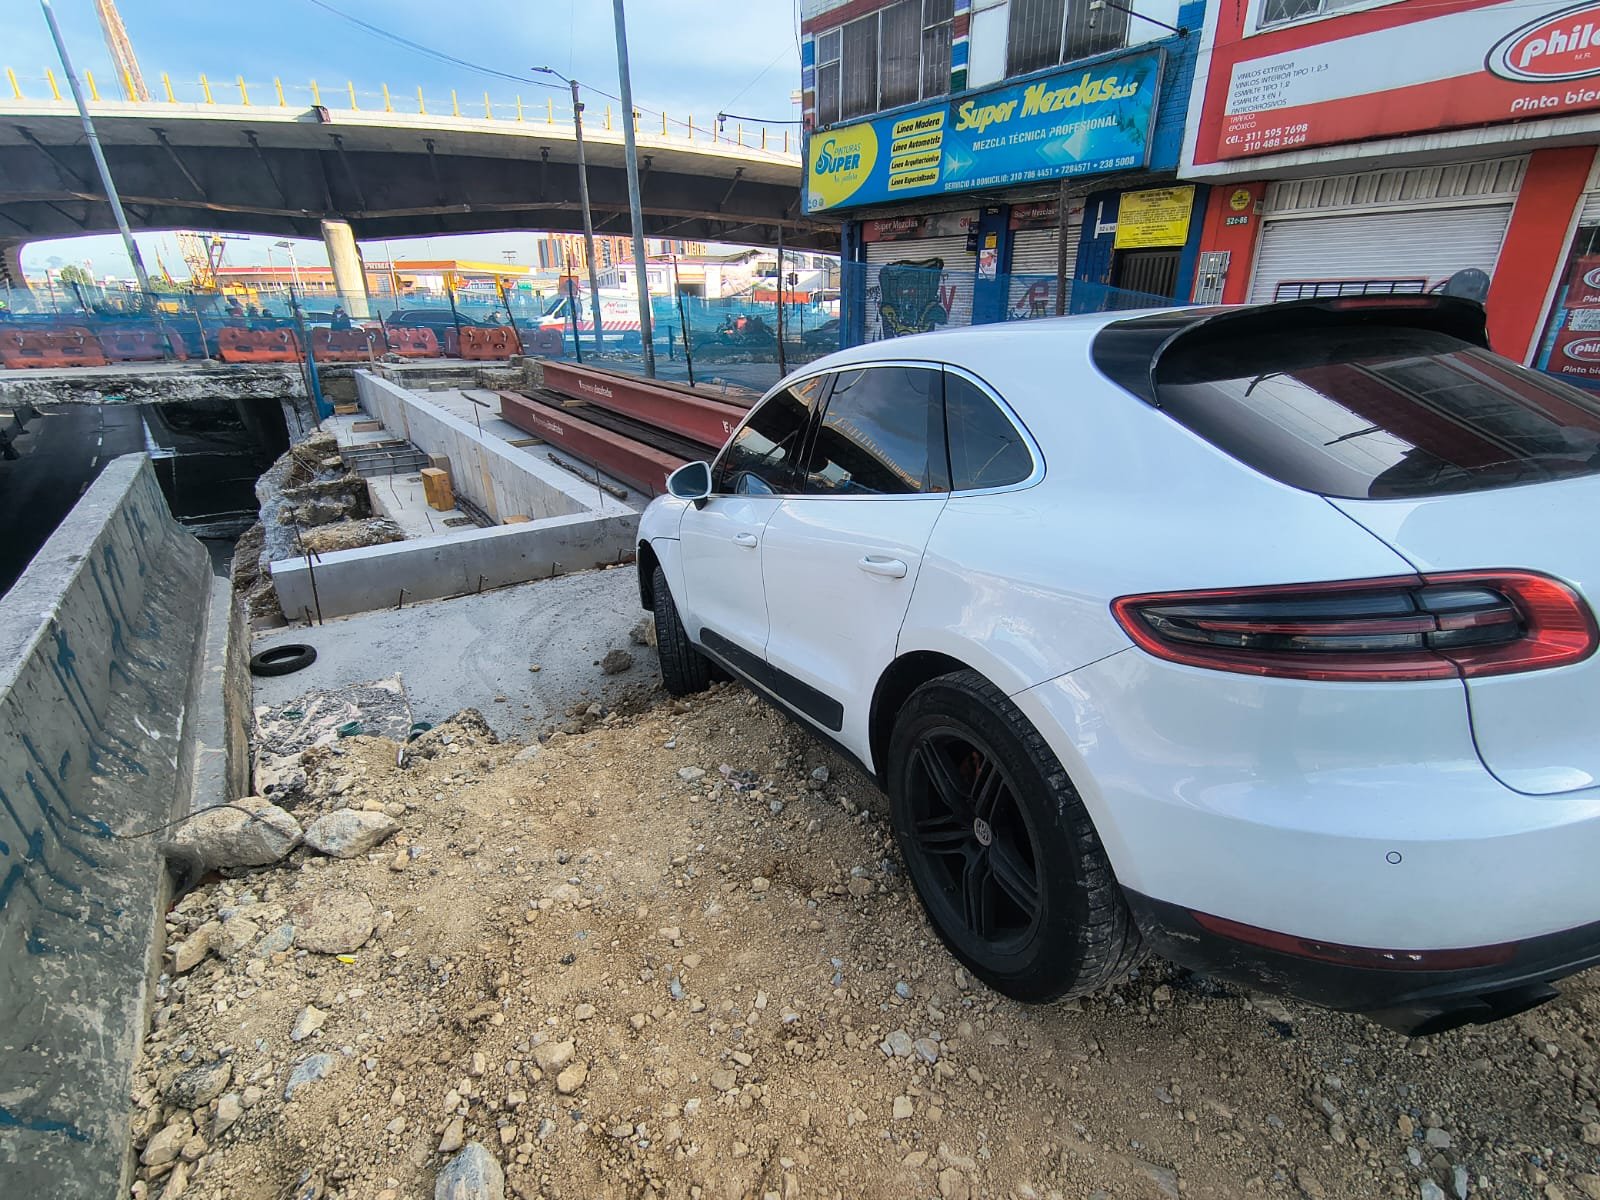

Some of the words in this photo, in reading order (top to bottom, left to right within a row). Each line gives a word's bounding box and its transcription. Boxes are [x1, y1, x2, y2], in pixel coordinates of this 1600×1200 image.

[1293, 67, 1309, 77] TIPO
[1234, 87, 1261, 97] ESMALTE
[1263, 83, 1278, 92] TIPO
[955, 100, 1018, 134] Super
[1020, 73, 1118, 118] Mezclas
[1232, 96, 1259, 106] ESMALTE
[1510, 95, 1559, 112] Pinta
[914, 118, 940, 130] Madera
[972, 138, 1006, 152] MEZCLA
[1008, 129, 1046, 145] TÉCNICA
[1049, 115, 1118, 138] PROFESIONAL
[1245, 131, 1261, 142] 311
[1264, 128, 1281, 138] 595
[1285, 123, 1308, 135] 7698
[907, 135, 941, 149] Automotriz
[1243, 141, 1260, 151] 310
[1263, 138, 1280, 149] 488
[1282, 134, 1306, 145] 3644
[874, 221, 892, 231] Super
[892, 218, 918, 229] Mezclas
[1562, 365, 1587, 374] Pinta
